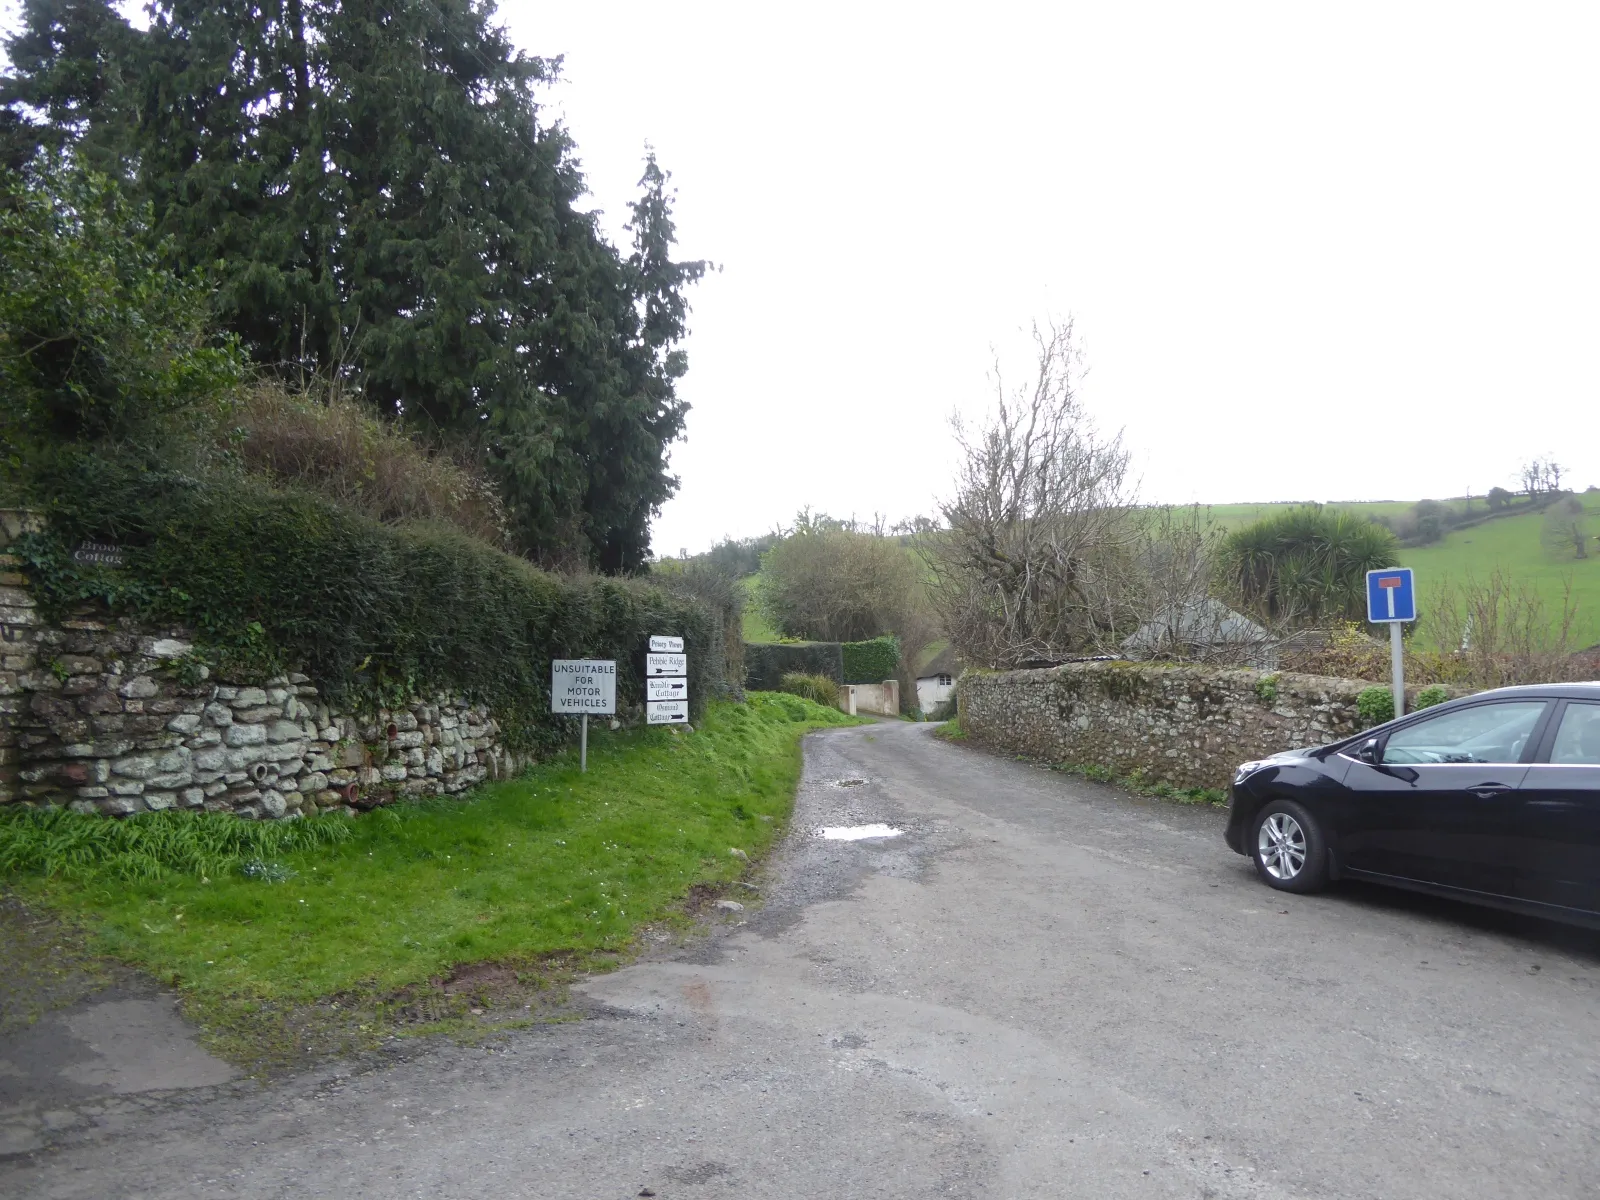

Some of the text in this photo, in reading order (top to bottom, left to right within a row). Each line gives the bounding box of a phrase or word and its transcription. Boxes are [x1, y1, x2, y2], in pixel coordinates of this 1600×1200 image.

[651, 640, 666, 648] Priory
[649, 657, 684, 667] Pebble Ridge
[554, 665, 614, 674] UNSUITABLE
[561, 698, 606, 707] VEHICLES
[650, 713, 670, 721] Cottage
